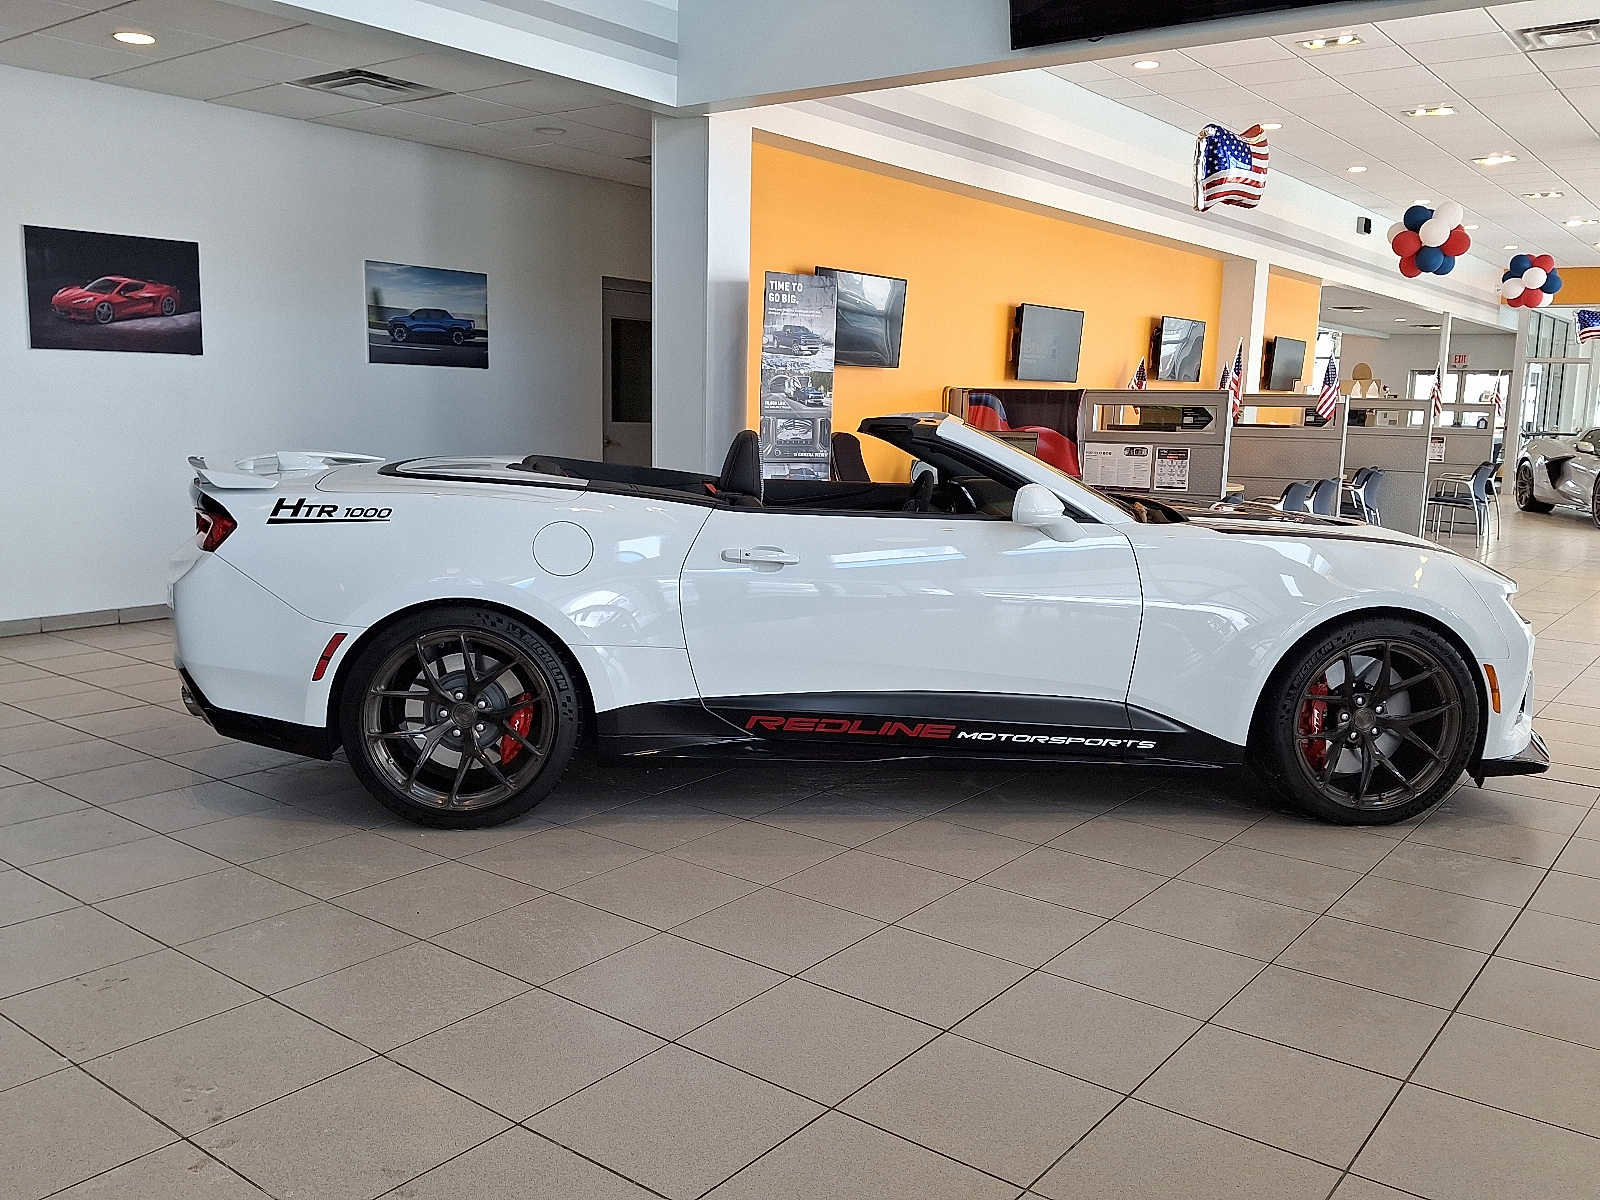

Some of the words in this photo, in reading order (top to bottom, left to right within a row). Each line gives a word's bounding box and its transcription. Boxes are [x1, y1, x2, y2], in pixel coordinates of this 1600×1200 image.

[769, 280, 790, 292] TIME
[791, 282, 804, 293] TO
[768, 292, 781, 303] GO
[1454, 354, 1467, 364] EXIT
[344, 507, 393, 519] 1000
[520, 632, 569, 691] MICHELIN
[745, 715, 957, 739] REDLINE
[957, 730, 1157, 749] MOTORSPORTS
